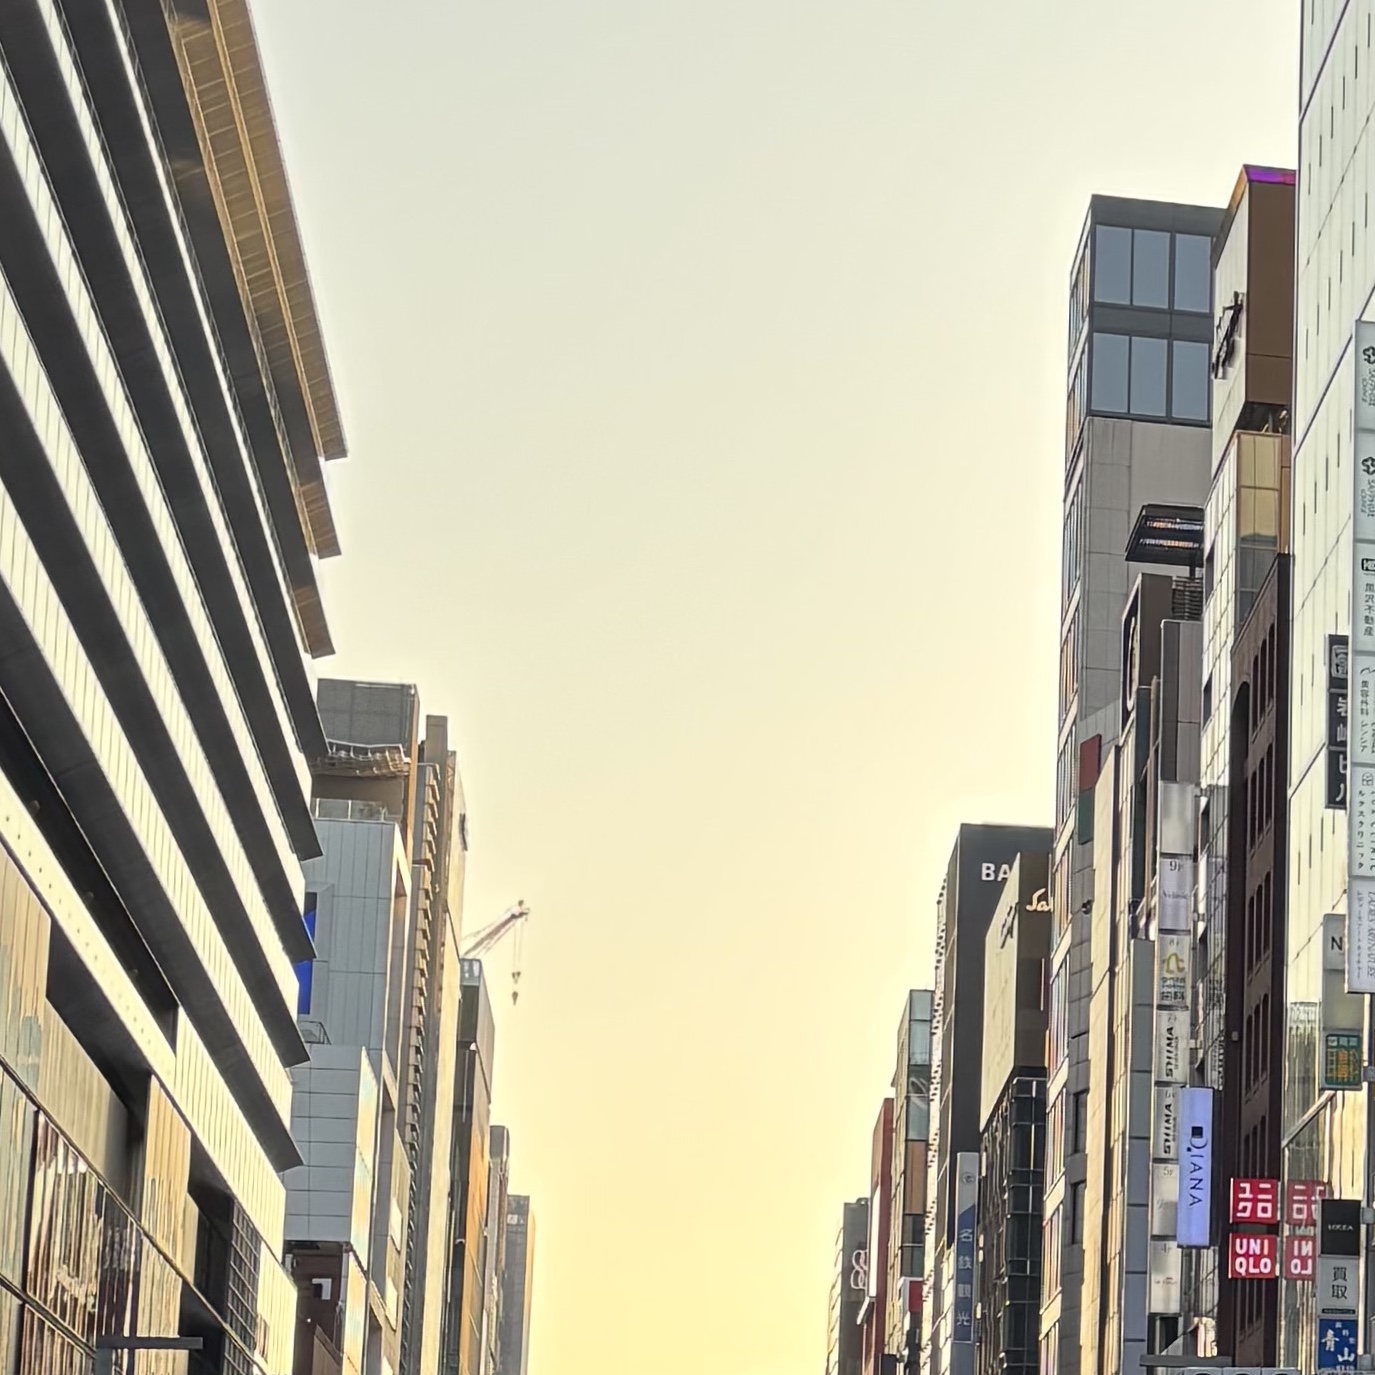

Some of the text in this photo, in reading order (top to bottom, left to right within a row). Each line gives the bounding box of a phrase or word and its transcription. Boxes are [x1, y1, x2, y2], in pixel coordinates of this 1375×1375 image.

[1238, 1183, 1272, 1199] ユニ
[1236, 1202, 1272, 1219] クロ
[1235, 1238, 1269, 1255] UNI
[1235, 1257, 1272, 1277] QLO
[1331, 1266, 1348, 1300] 買取
